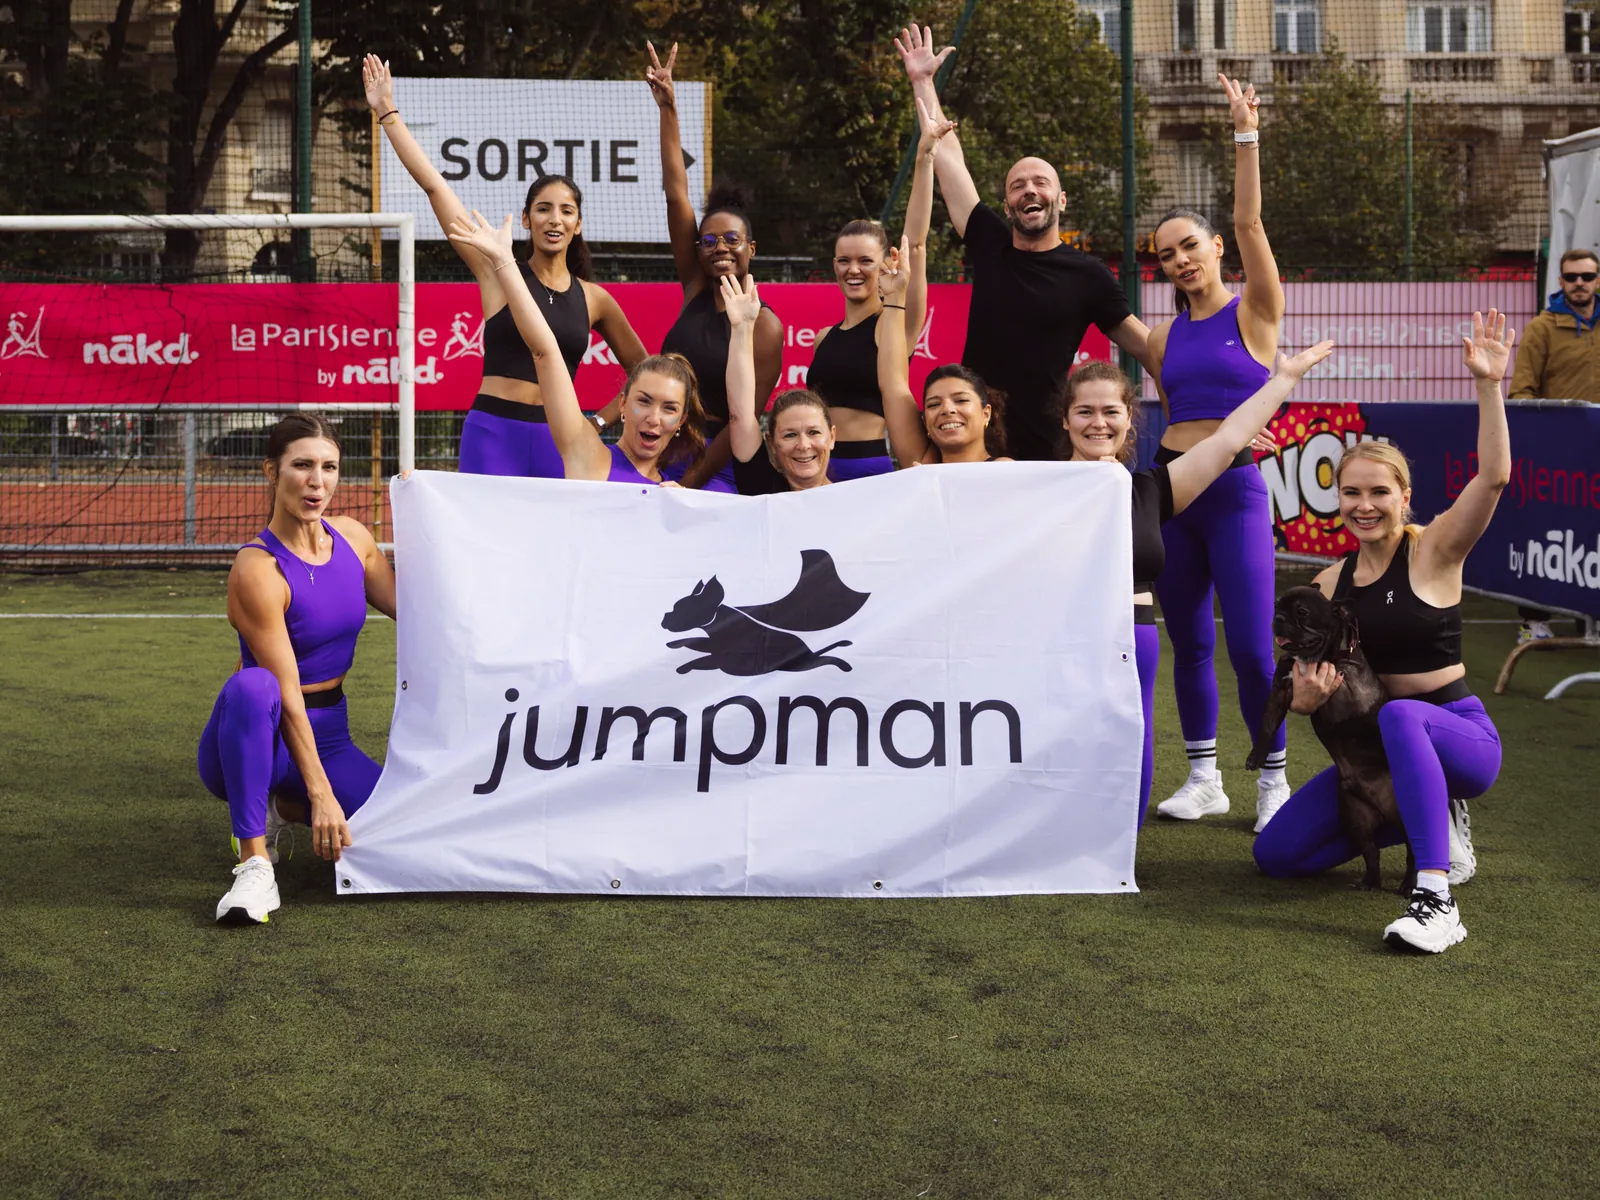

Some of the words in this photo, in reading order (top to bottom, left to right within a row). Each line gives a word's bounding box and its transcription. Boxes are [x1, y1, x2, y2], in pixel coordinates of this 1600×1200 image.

[440, 138, 639, 183] SORTIE
[317, 368, 337, 388] by
[1509, 543, 1524, 579] by
[473, 687, 1023, 795] jumpman
